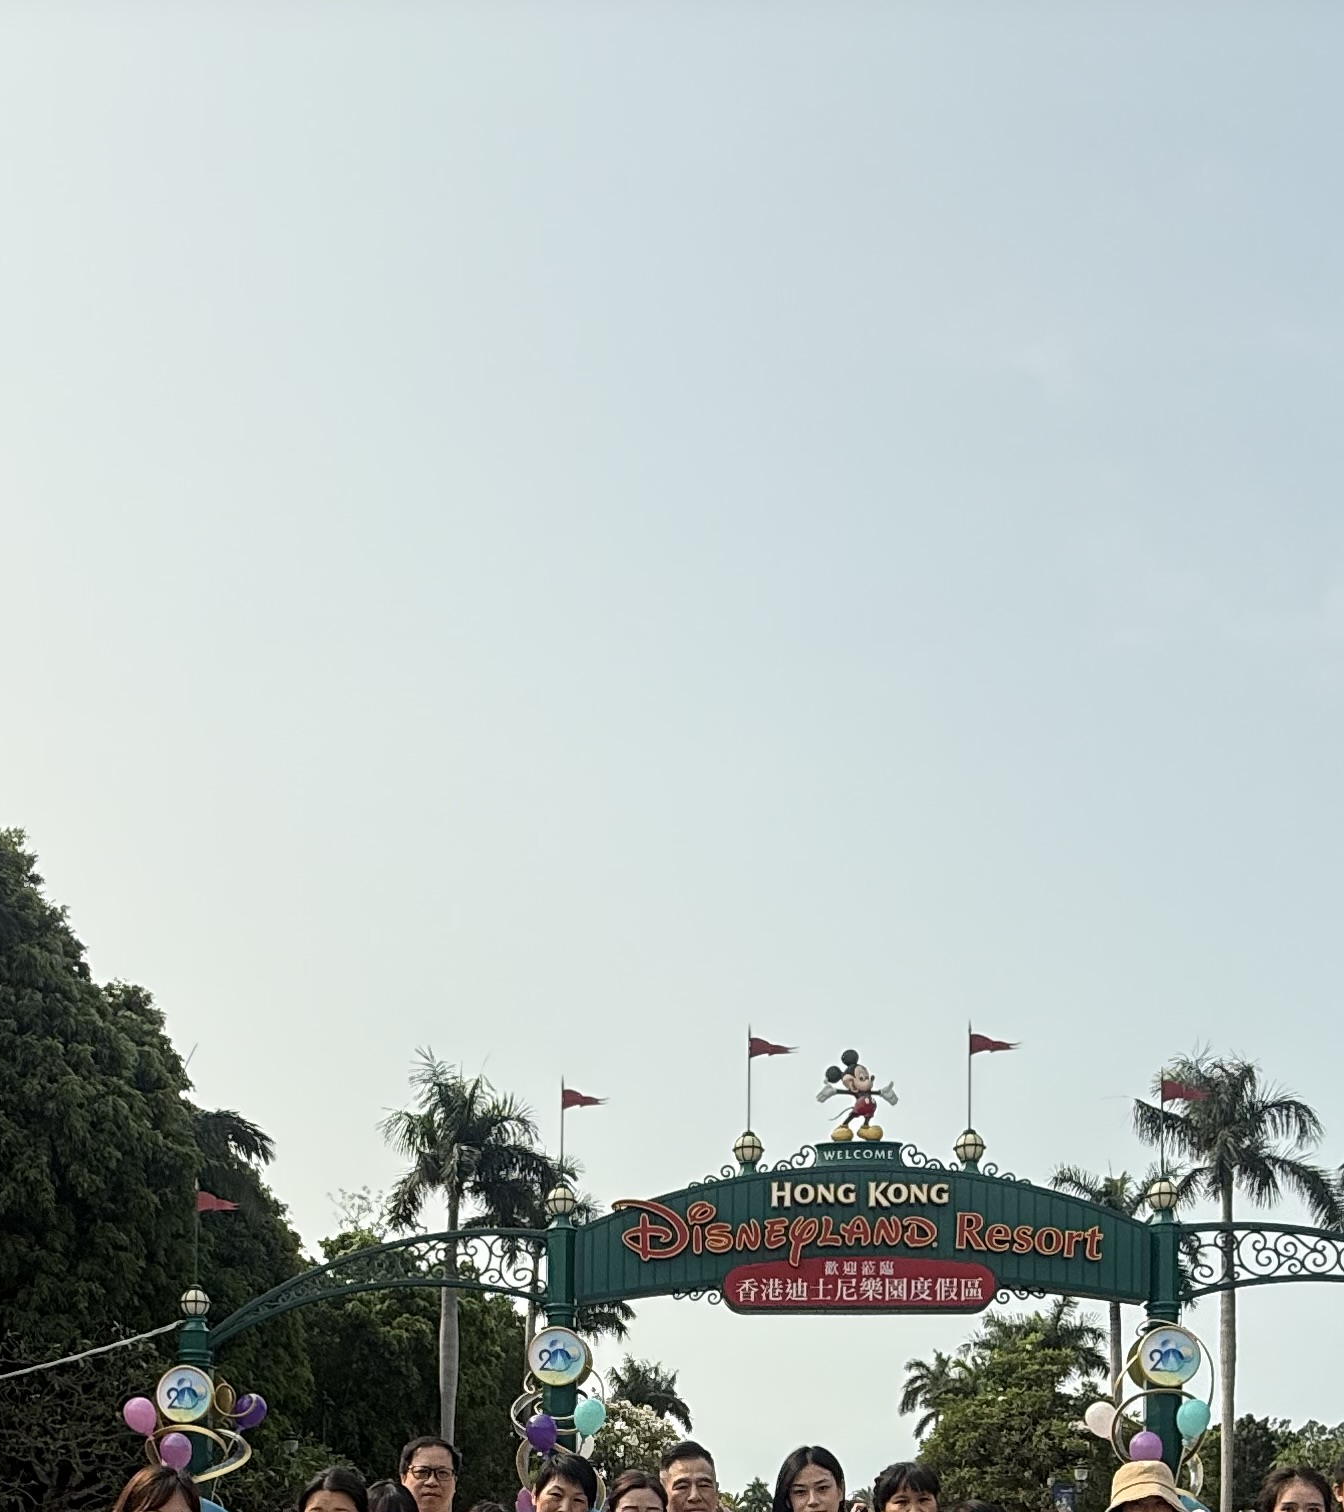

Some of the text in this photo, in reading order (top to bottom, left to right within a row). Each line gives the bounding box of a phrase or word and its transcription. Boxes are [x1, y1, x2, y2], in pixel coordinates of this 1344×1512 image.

[823, 1149, 894, 1160] WELCOME
[770, 1181, 950, 1208] HONG KONG
[955, 1211, 1104, 1261] Resort
[735, 1276, 984, 1302] 香港迪士尼樂園度假區
